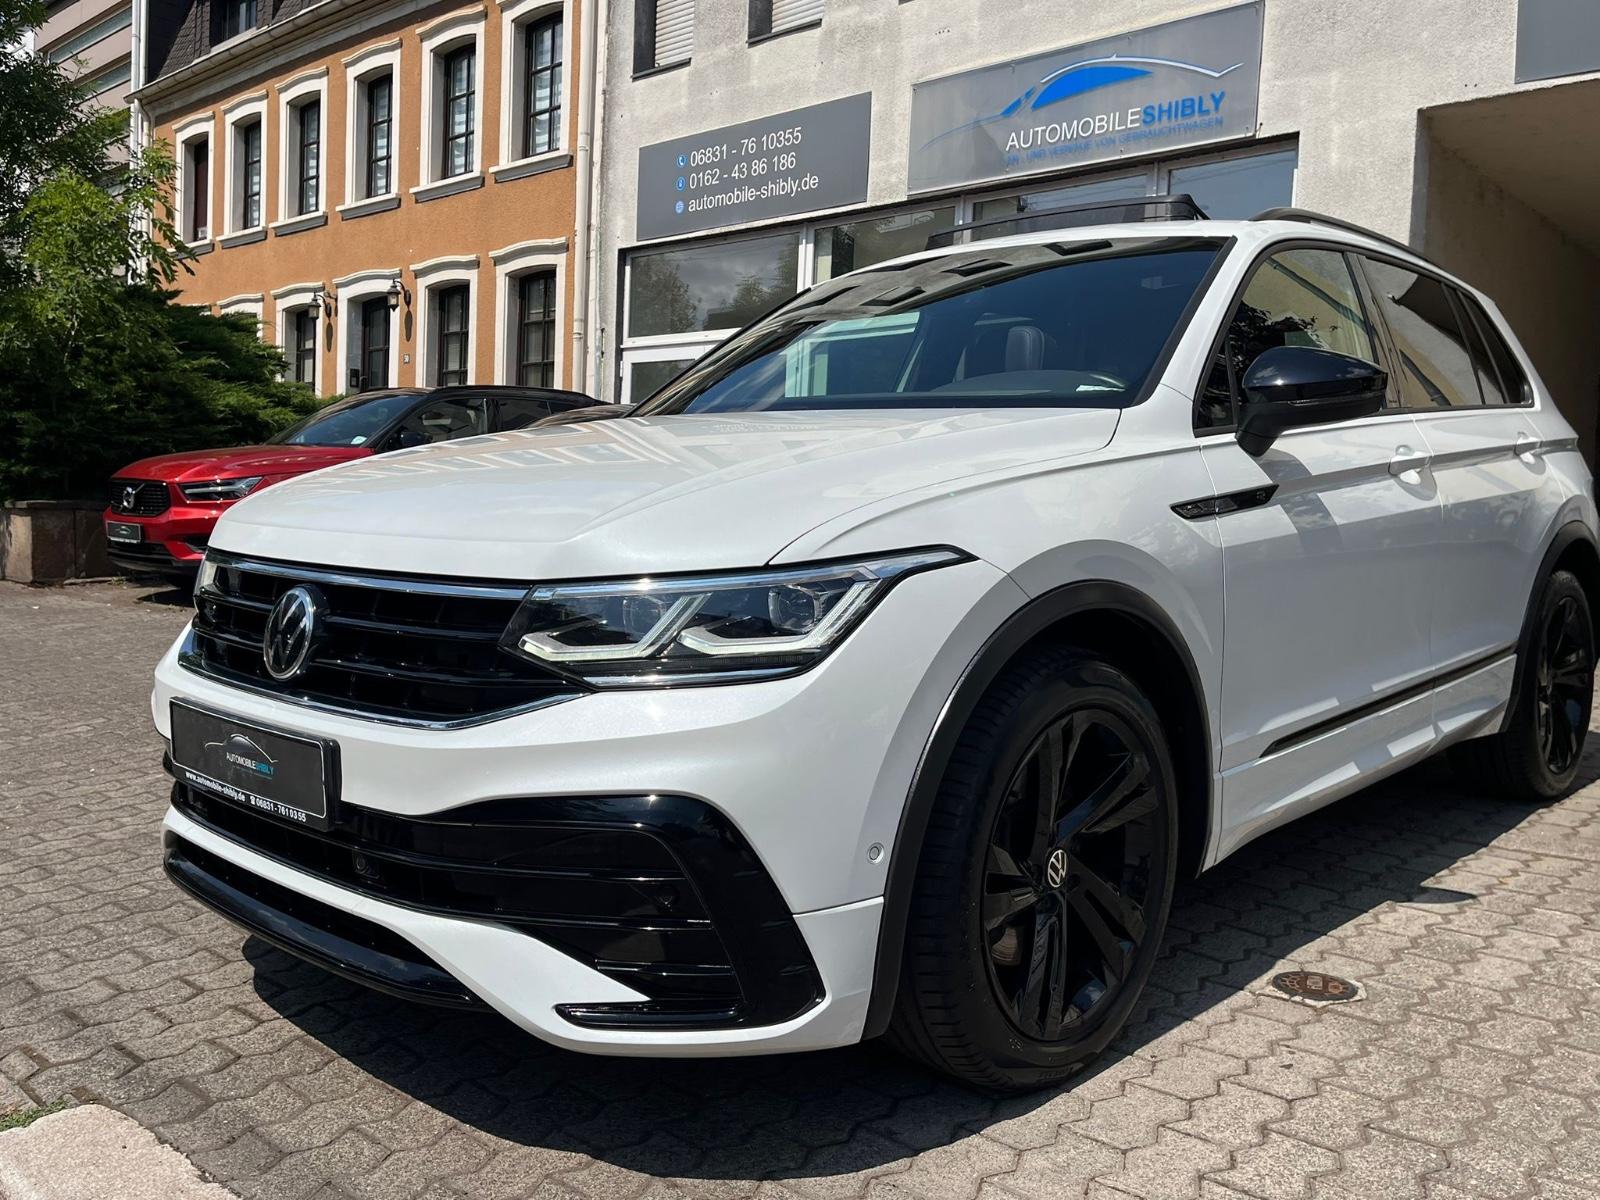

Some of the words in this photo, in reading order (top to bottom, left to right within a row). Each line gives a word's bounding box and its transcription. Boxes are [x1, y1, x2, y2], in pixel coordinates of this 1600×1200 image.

[690, 144, 727, 167] 06831
[741, 137, 756, 155] 76
[761, 127, 802, 150] 10355
[689, 169, 720, 189] 0162
[731, 163, 748, 180] 43
[751, 158, 767, 176] 86
[772, 152, 796, 172] 186
[688, 173, 819, 212] automobile-shibly.de
[185, 771, 246, 802] www.automobile-shibly.de
[256, 798, 274, 812] 06831
